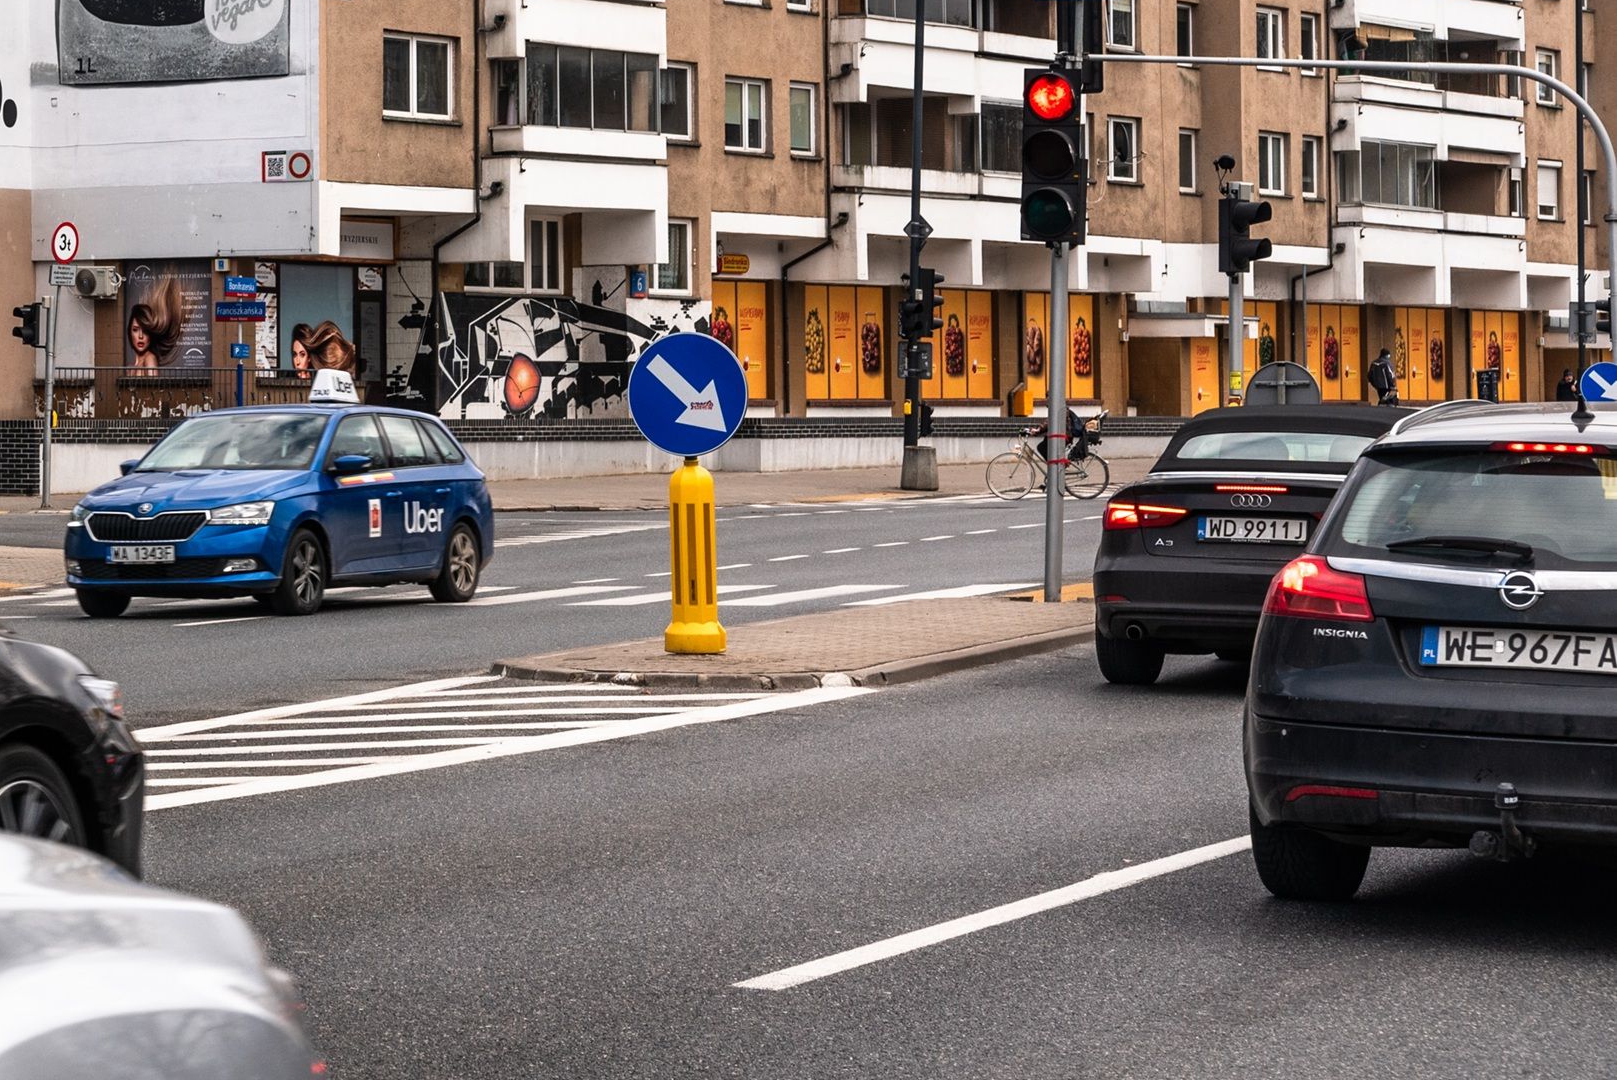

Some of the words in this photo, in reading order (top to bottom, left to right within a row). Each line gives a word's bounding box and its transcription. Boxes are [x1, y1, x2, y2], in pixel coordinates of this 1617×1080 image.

[216, 304, 263, 316] Franciszkańska
[332, 376, 352, 393] Uber
[404, 501, 444, 533] Uber
[1210, 519, 1236, 537] WD
[1244, 520, 1303, 540] 9911J
[1155, 538, 1173, 546] A3
[1313, 628, 1369, 639] INSIGNIA
[1424, 649, 1436, 658] PL
[1445, 630, 1495, 662] WE
[1508, 633, 1617, 669] 967FA
